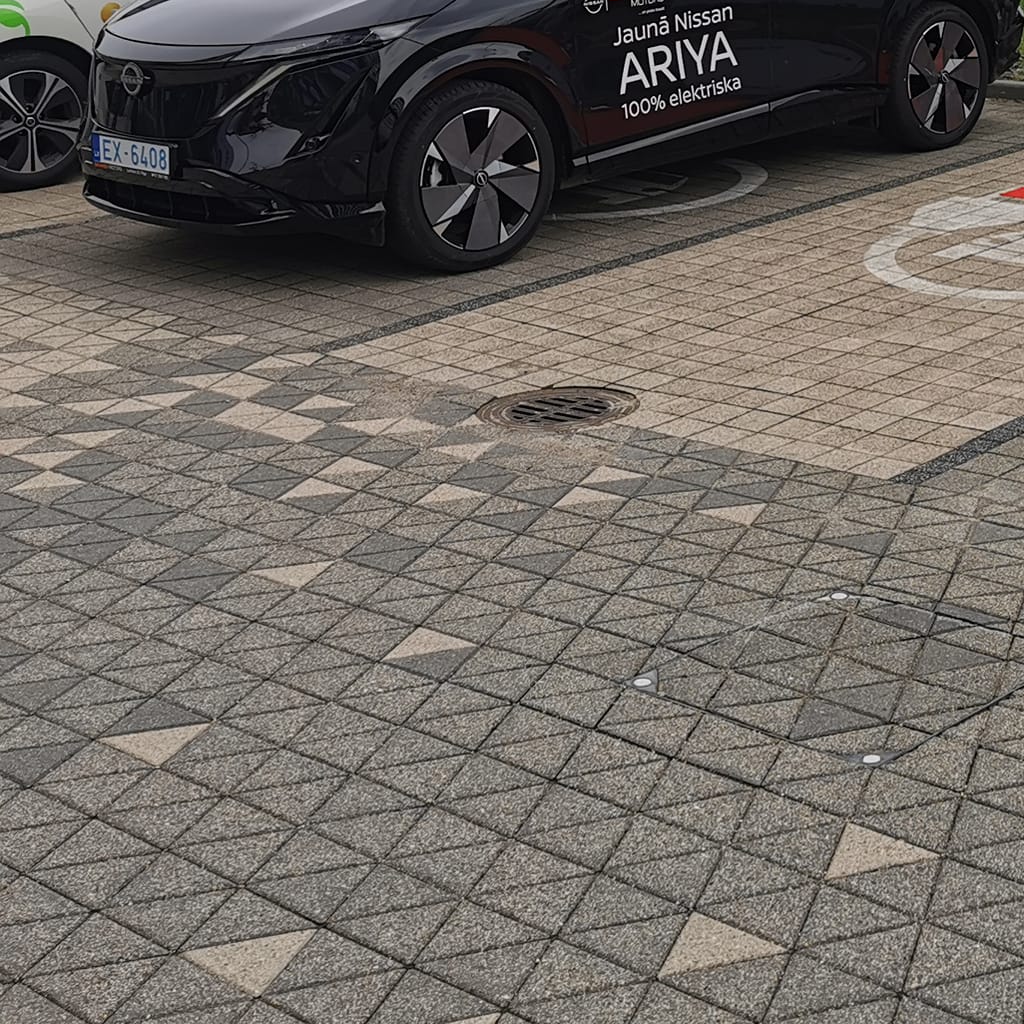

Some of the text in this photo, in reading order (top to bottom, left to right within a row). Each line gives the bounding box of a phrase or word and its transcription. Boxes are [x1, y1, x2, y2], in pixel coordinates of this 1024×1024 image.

[613, 5, 734, 47] Jaunā Nissan
[619, 30, 739, 95] ARIYA
[621, 75, 742, 120] 100% elektriska
[102, 139, 168, 170] EX-6408
